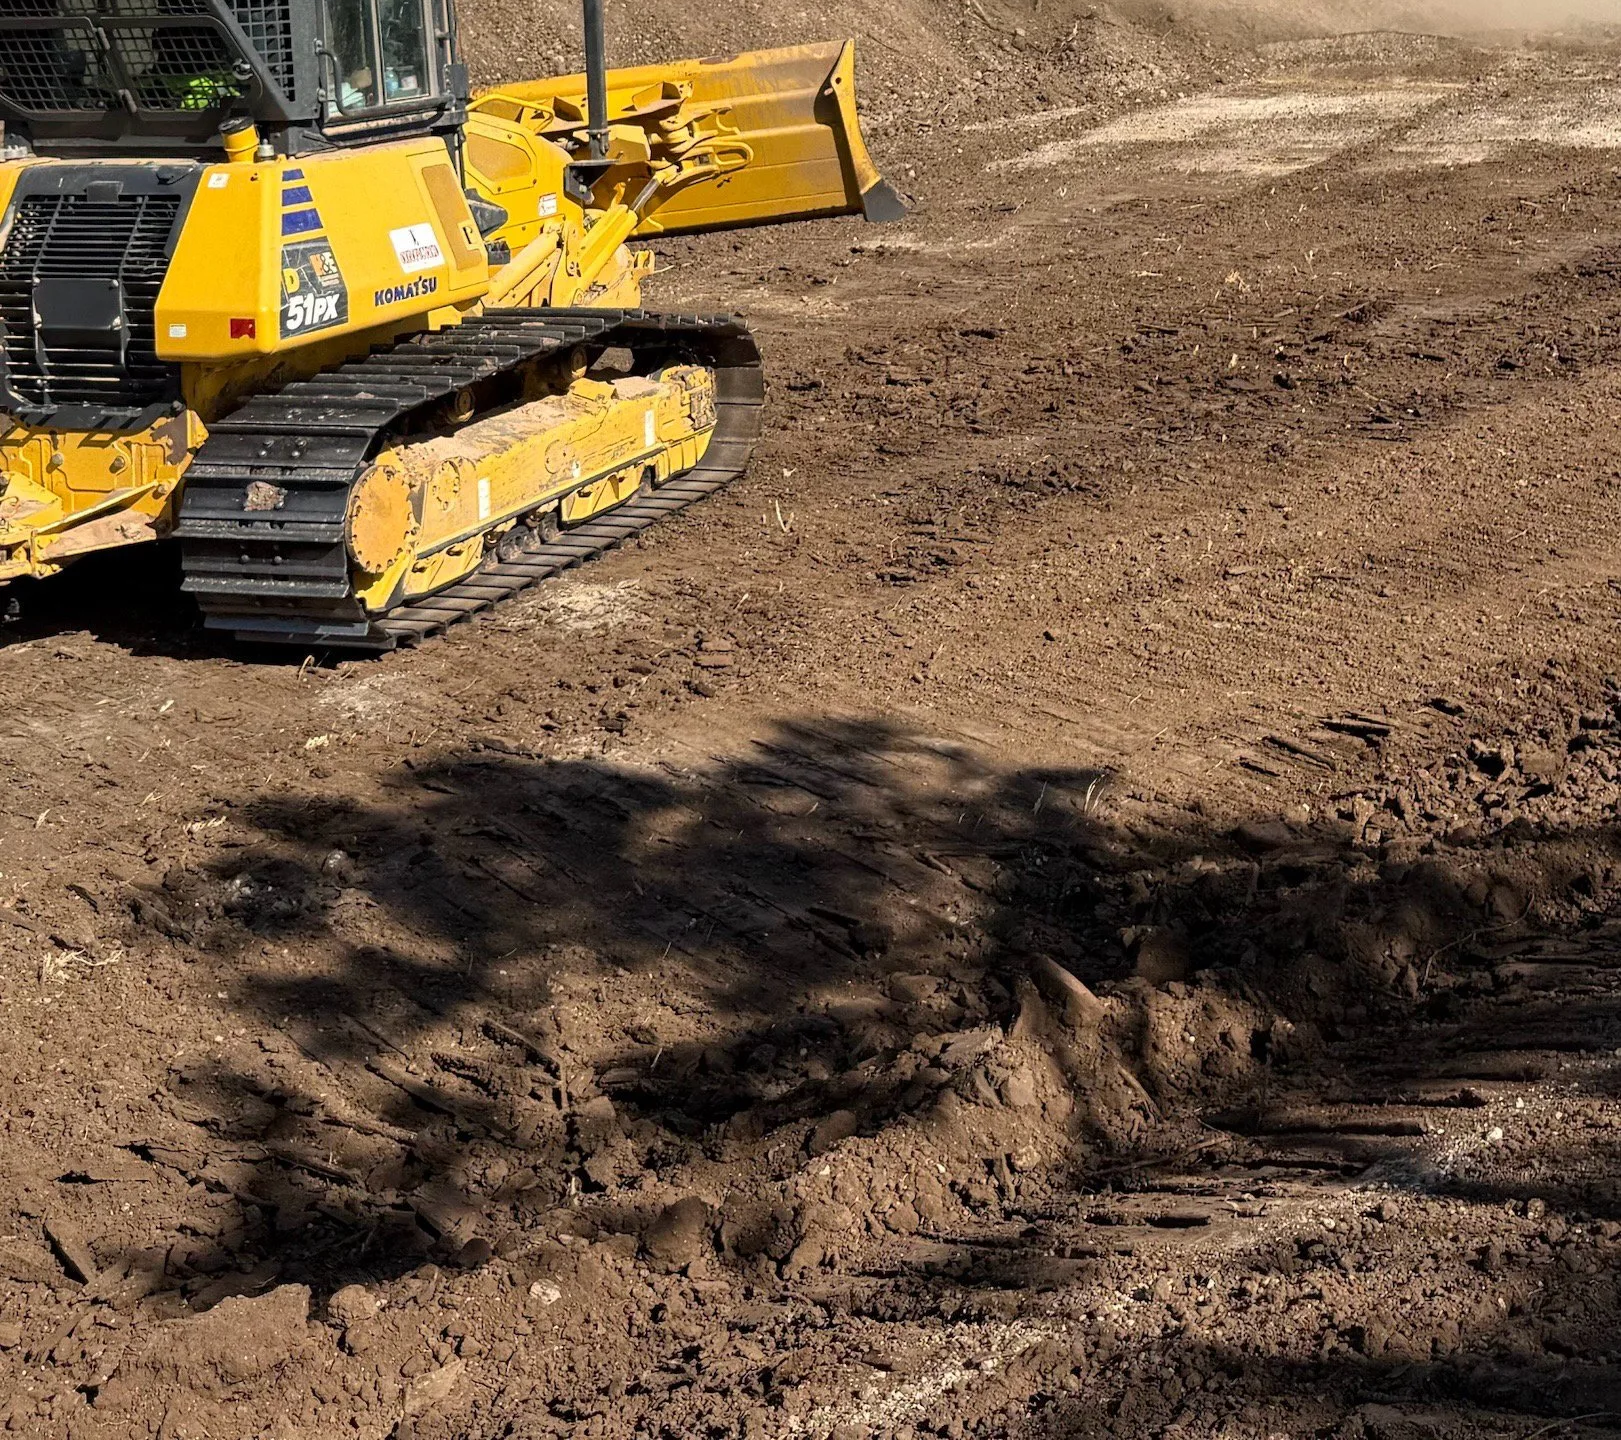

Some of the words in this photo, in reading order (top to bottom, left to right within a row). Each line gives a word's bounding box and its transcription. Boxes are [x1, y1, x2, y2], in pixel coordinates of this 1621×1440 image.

[283, 267, 300, 294] D
[375, 275, 437, 307] KOMATSU
[286, 292, 340, 330] 51PX
